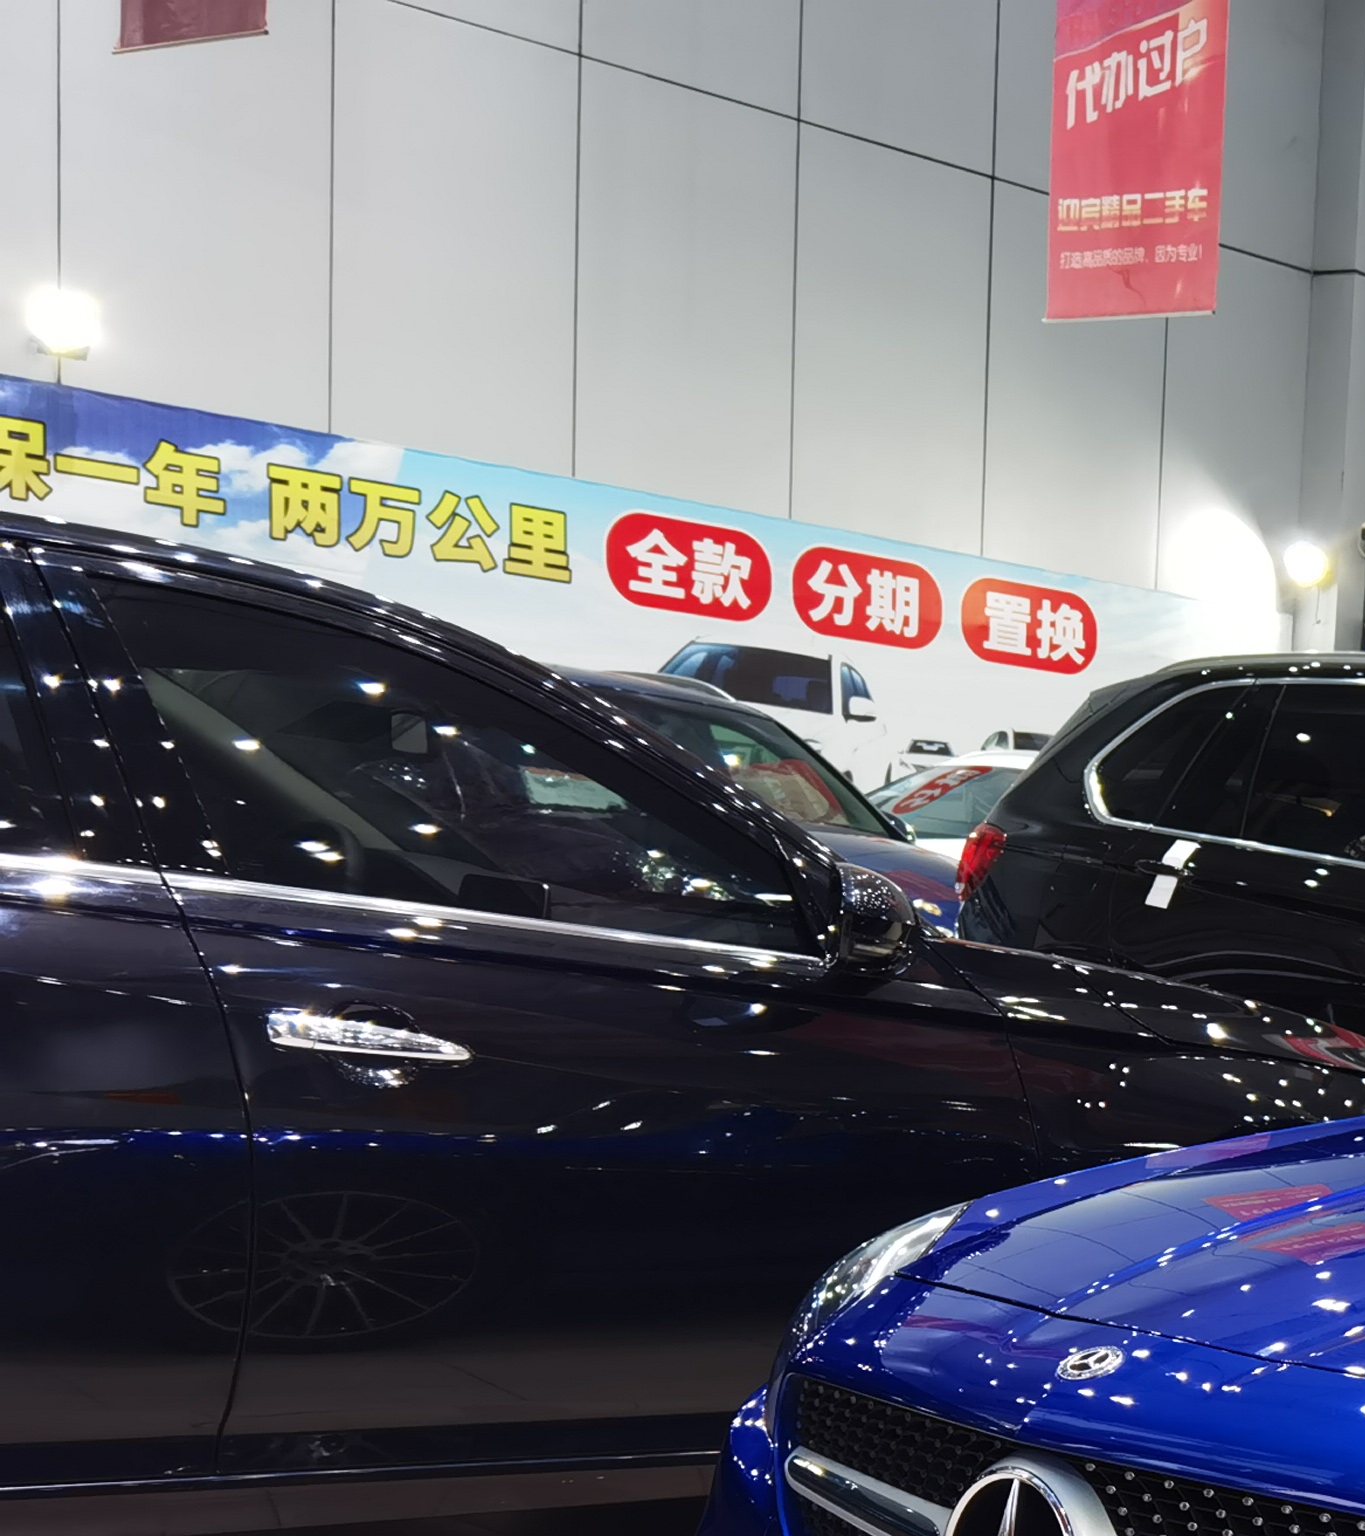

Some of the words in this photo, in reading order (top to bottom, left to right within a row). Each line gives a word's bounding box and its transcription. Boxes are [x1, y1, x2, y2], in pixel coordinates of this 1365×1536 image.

[1065, 18, 1208, 130] 代办过户
[1057, 188, 1208, 232] 迎宾精品二手车
[0, 416, 227, 527] 保一年
[267, 463, 572, 583] 两万公里
[626, 528, 752, 610] 全款
[807, 560, 920, 639] 分期
[983, 591, 1086, 665] 置换
